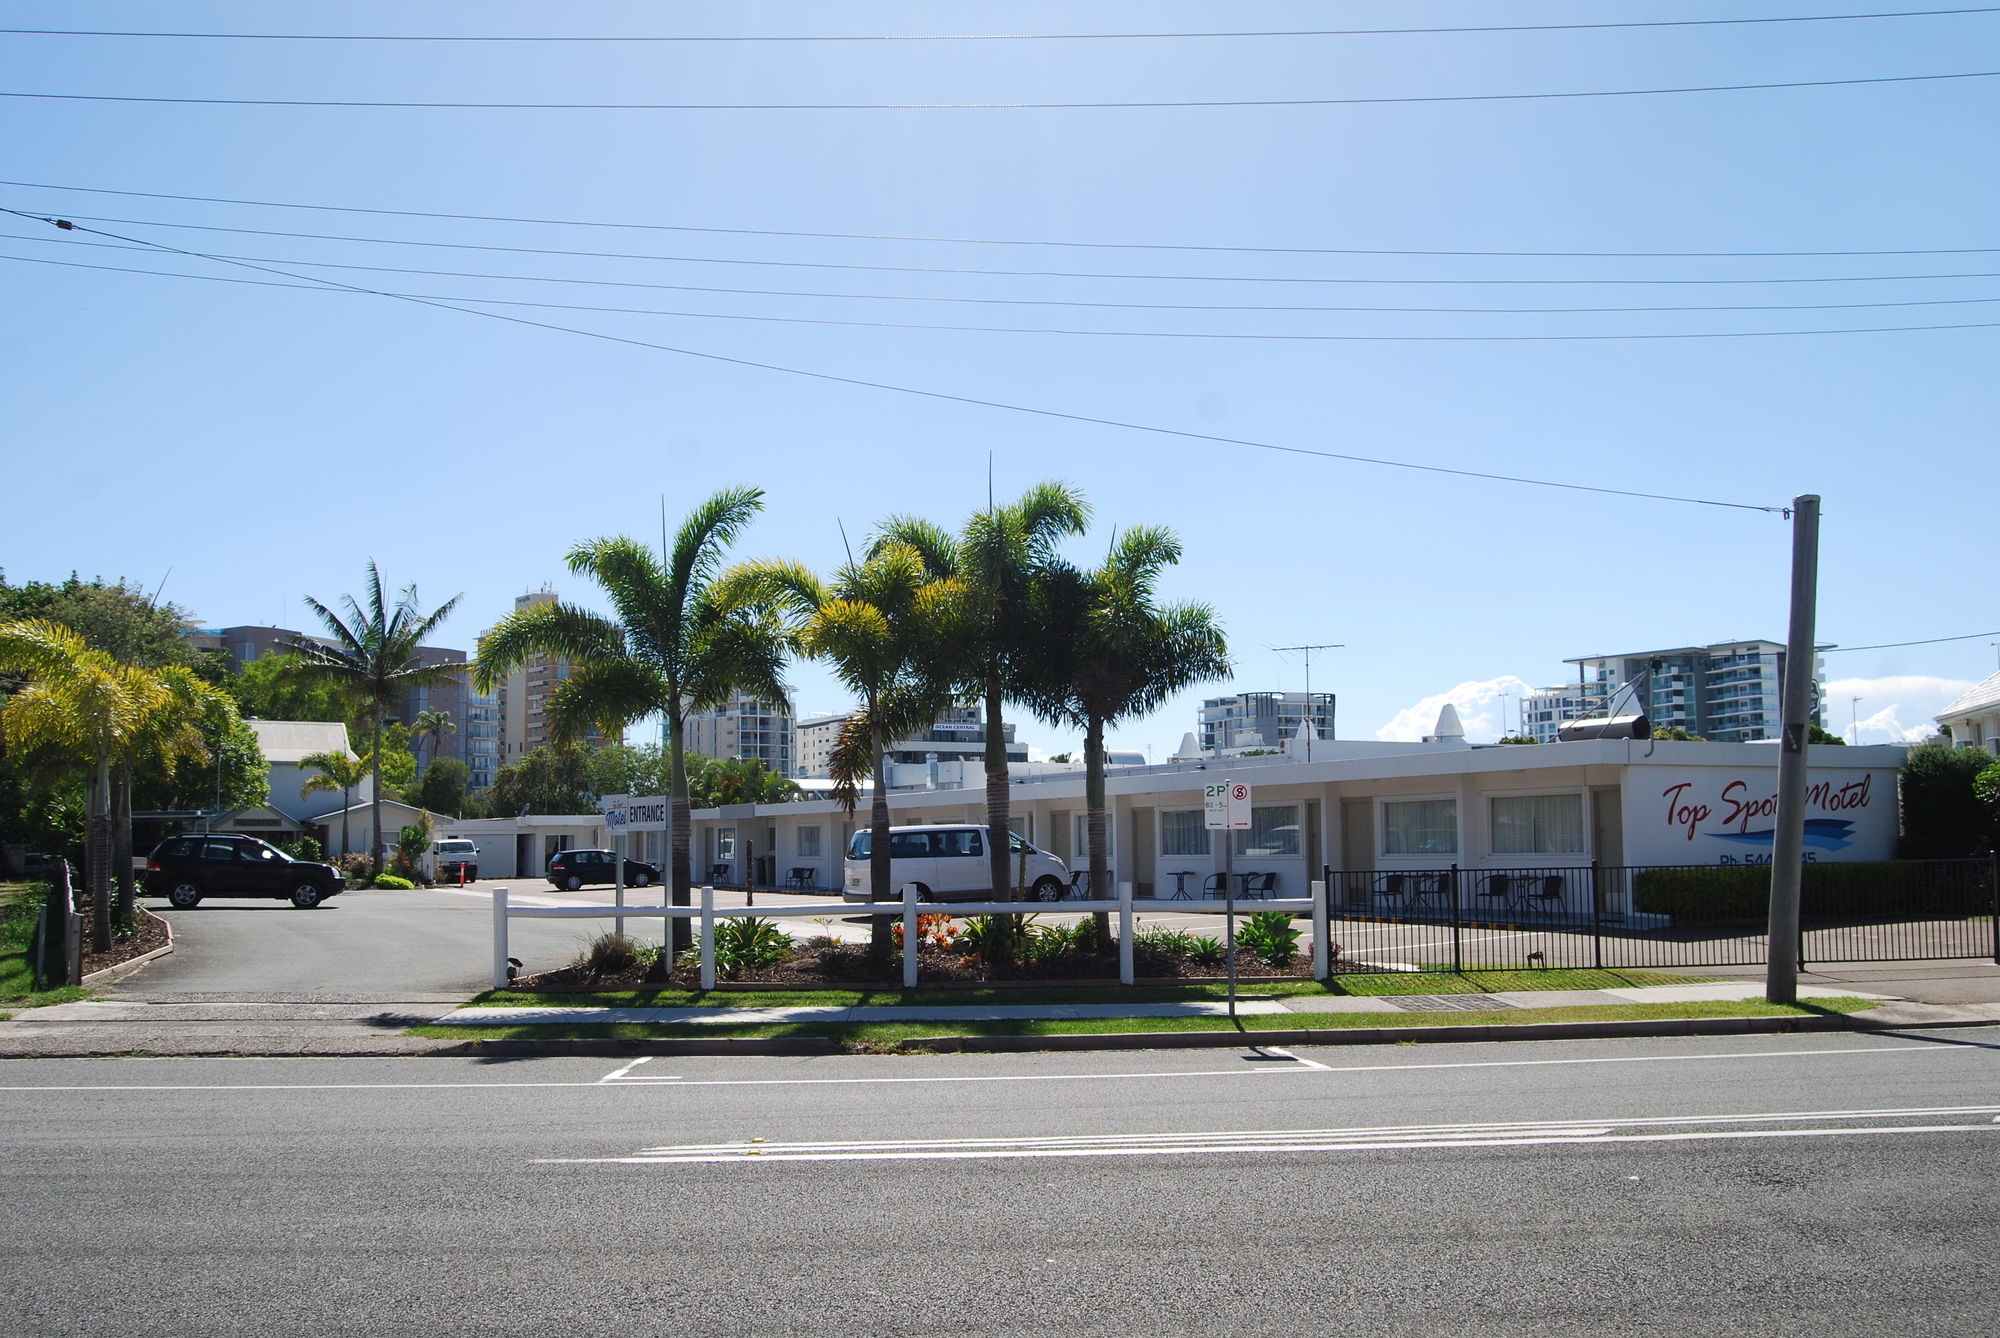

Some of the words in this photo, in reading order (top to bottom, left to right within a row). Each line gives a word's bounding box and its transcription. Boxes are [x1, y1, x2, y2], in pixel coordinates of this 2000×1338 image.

[1206, 785, 1226, 797] 2P
[629, 804, 664, 823] ENTRANCE
[1663, 782, 1712, 841] Top
[1805, 773, 1871, 812] Motel
[606, 810, 627, 830] Motel
